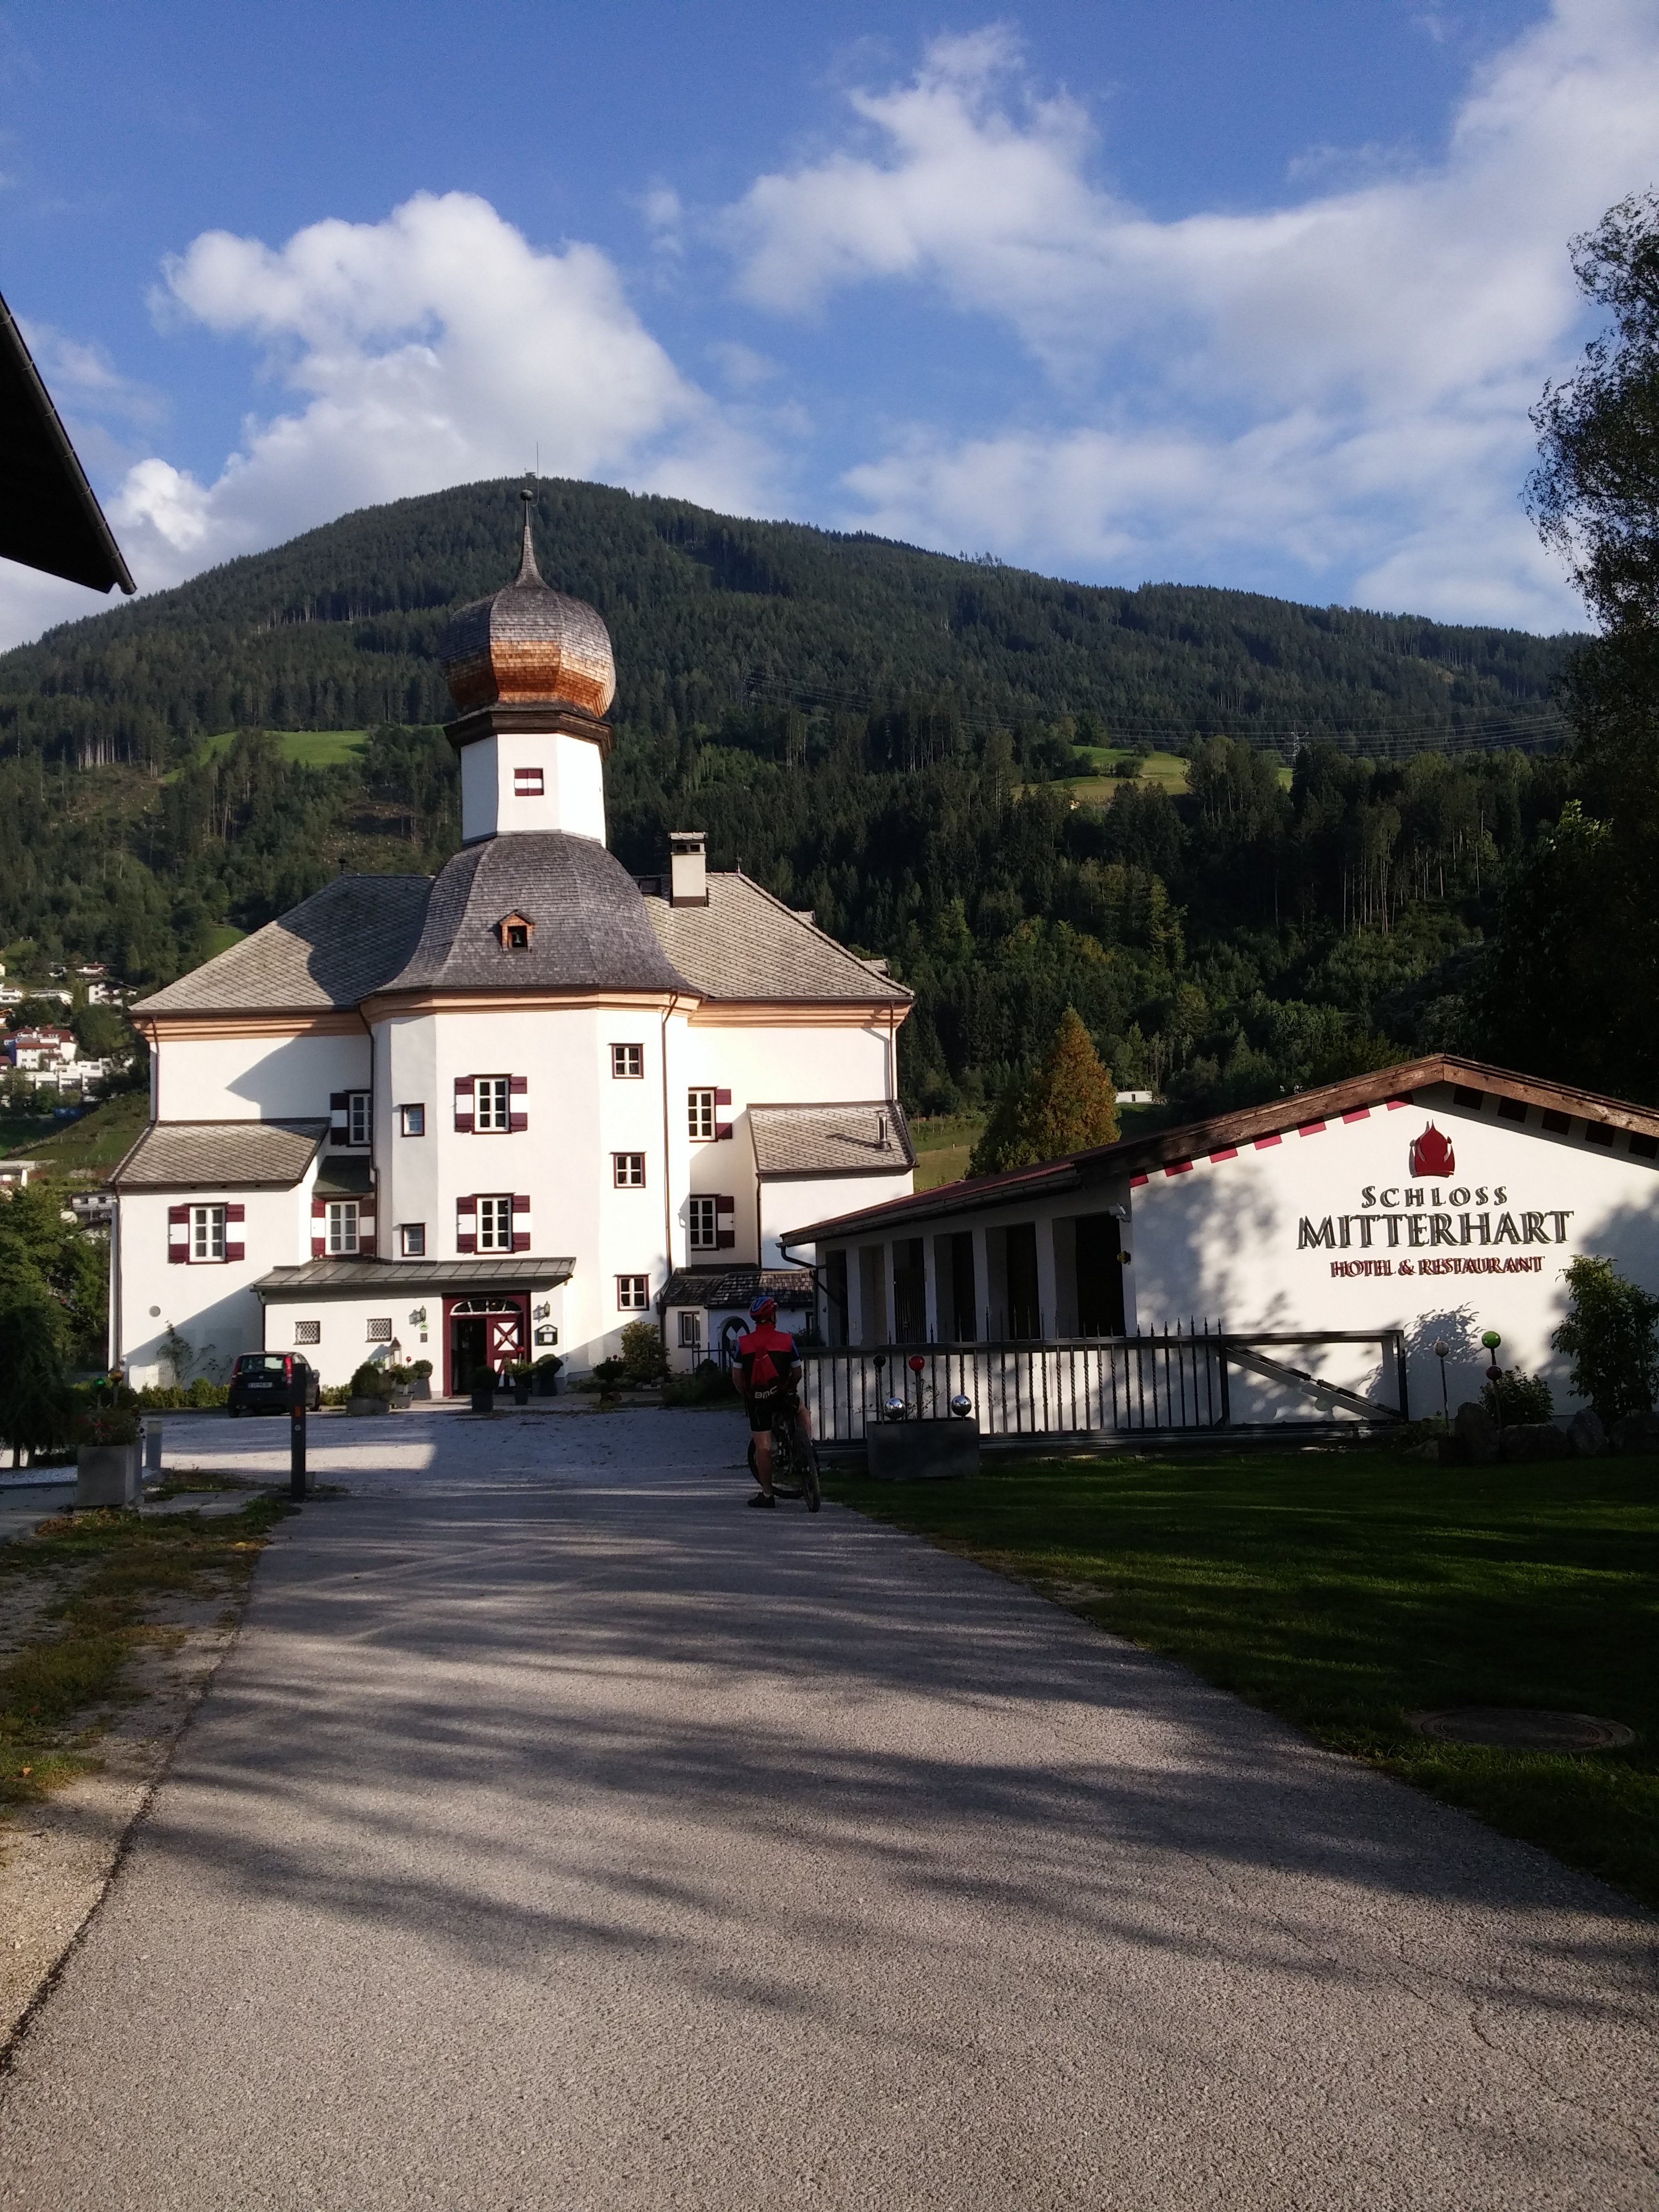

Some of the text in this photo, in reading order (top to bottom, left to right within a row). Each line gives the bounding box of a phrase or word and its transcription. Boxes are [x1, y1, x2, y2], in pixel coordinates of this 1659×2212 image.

[1362, 1186, 1507, 1208] SCHLOSS
[1297, 1210, 1574, 1249] MITTERHART
[1330, 1256, 1545, 1277] HOTEL & RESTAURANT
[755, 1386, 777, 1399] BMC
